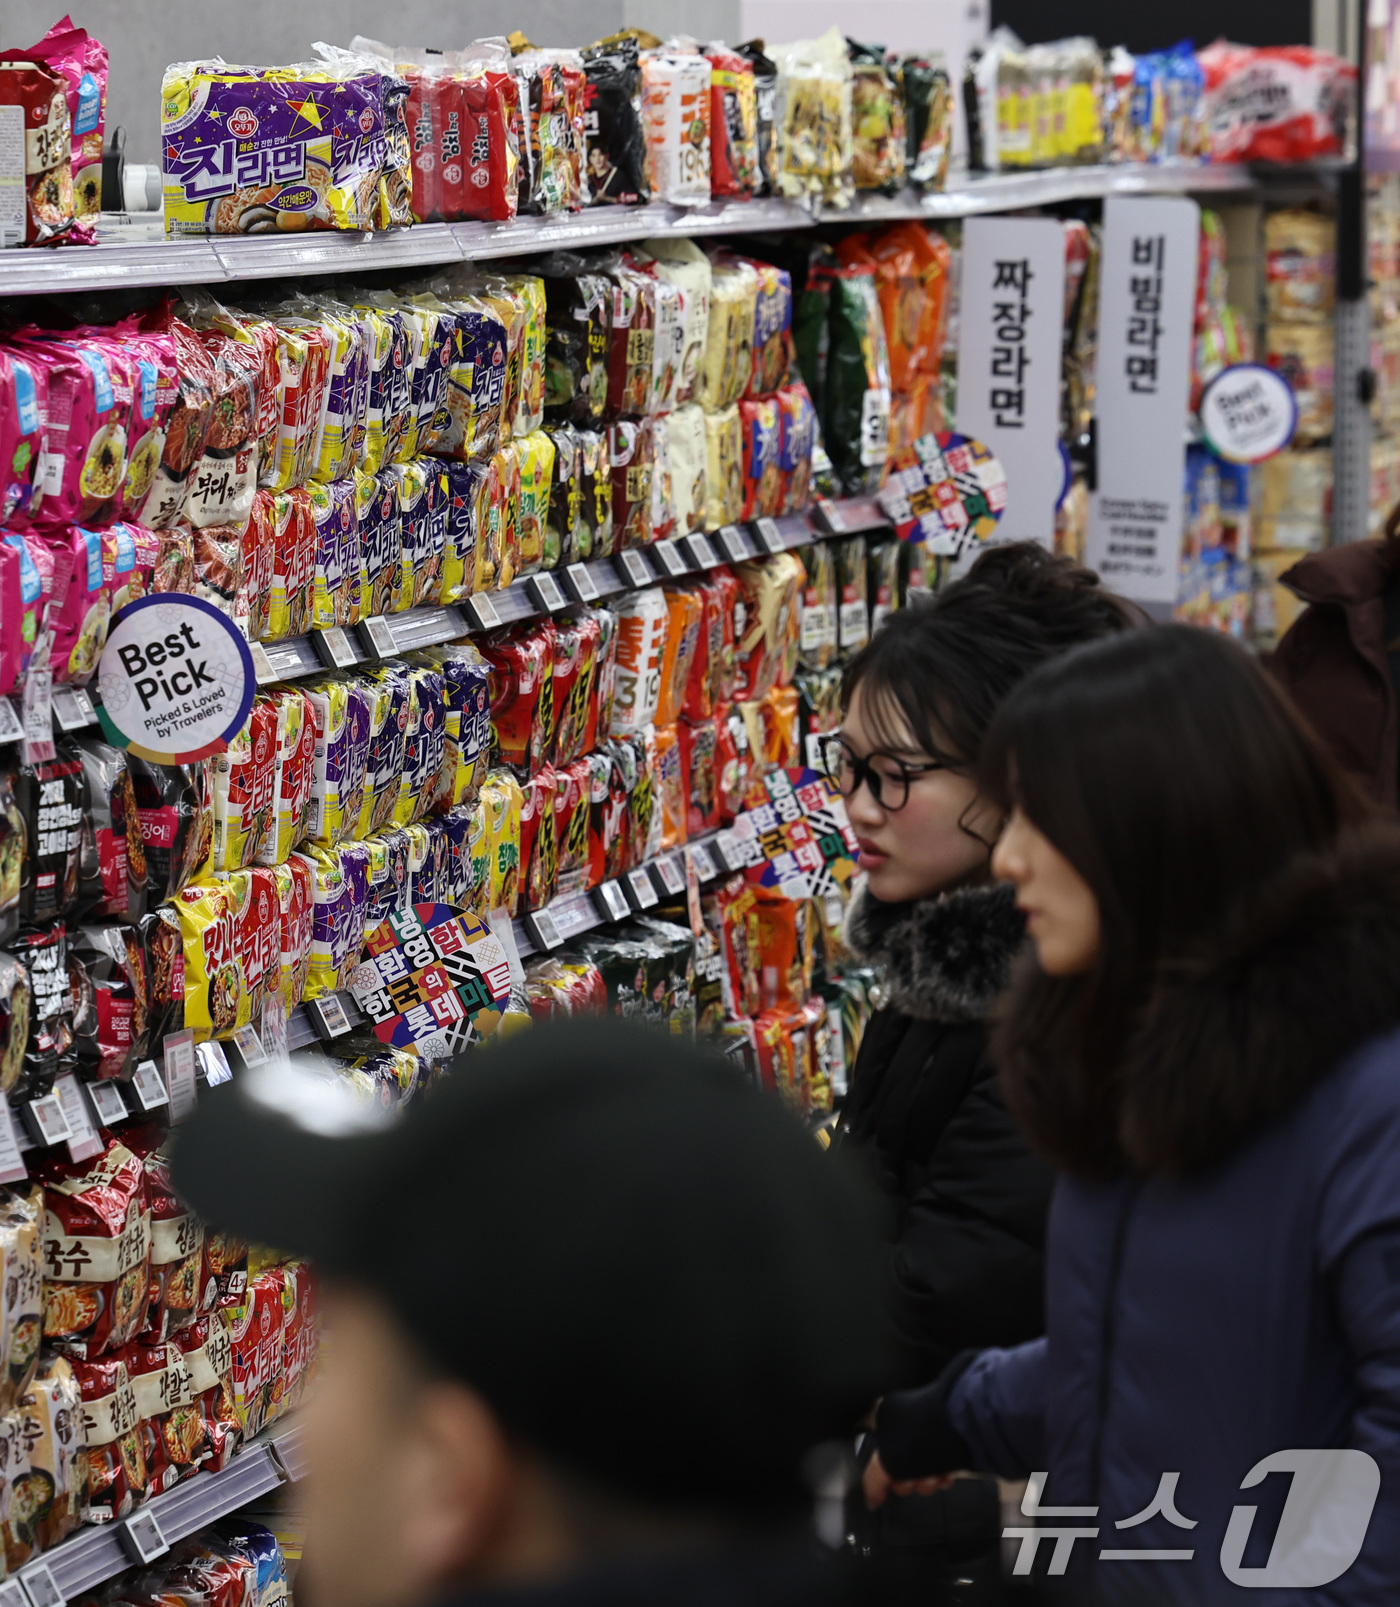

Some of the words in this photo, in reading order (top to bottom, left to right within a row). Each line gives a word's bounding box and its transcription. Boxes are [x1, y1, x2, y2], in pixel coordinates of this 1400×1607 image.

[234, 123, 253, 132] 오뚜기
[181, 139, 307, 203] 진라면
[278, 190, 313, 208] 약간매운맛
[1125, 234, 1166, 394] 비빔라면
[990, 258, 1035, 429] 짜장라면
[324, 530, 361, 595] 진라면
[117, 622, 201, 678] Best
[134, 658, 215, 712] Pick
[143, 702, 183, 731] Picked
[182, 702, 194, 714] &
[193, 687, 226, 710] Loved
[156, 724, 172, 738] by
[172, 702, 224, 732] Travelers
[368, 905, 422, 955] 안녕
[362, 970, 444, 1024] 한국의
[404, 963, 511, 1040] 롯데마트
[243, 1337, 282, 1410] 진라면
